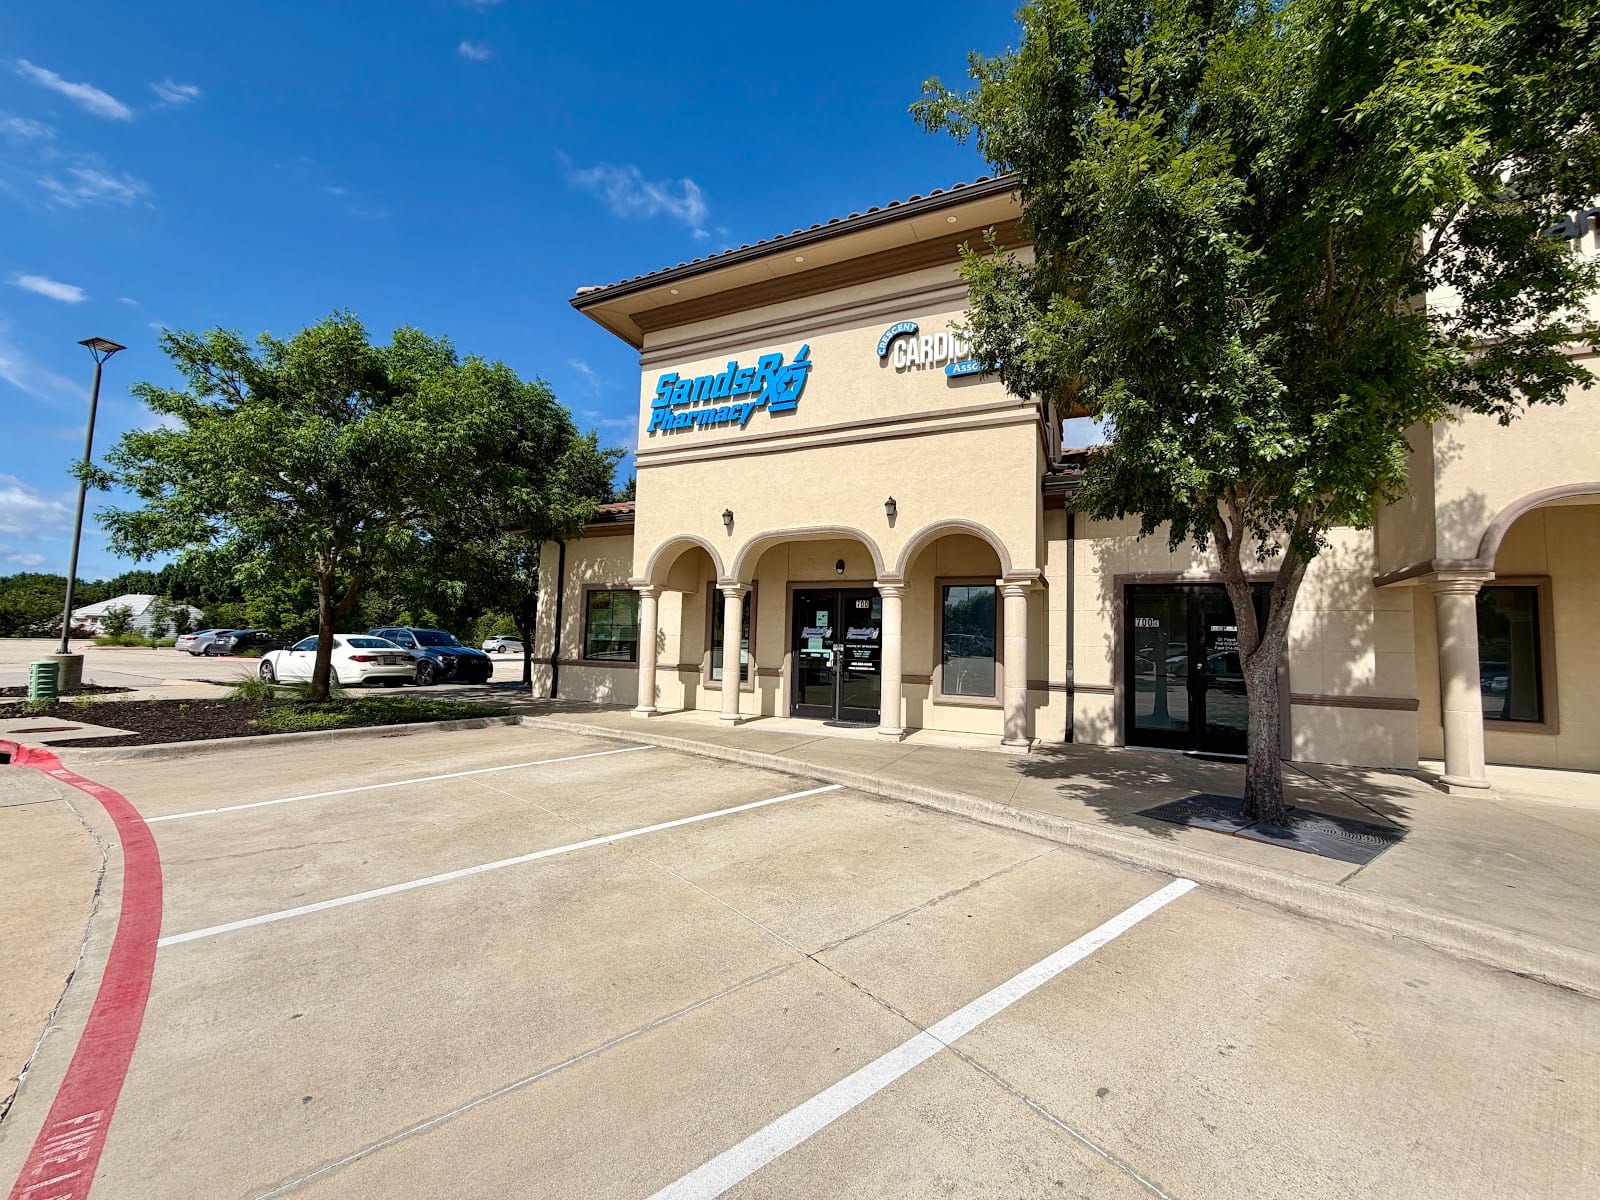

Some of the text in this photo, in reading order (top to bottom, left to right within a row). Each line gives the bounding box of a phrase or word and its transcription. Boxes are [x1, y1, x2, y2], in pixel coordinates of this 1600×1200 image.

[877, 321, 918, 355] CRESCENT
[893, 329, 977, 369] CARDIO
[646, 401, 756, 432] Pharmacy
[855, 600, 869, 608] 700
[31, 1108, 104, 1175] FIRE
